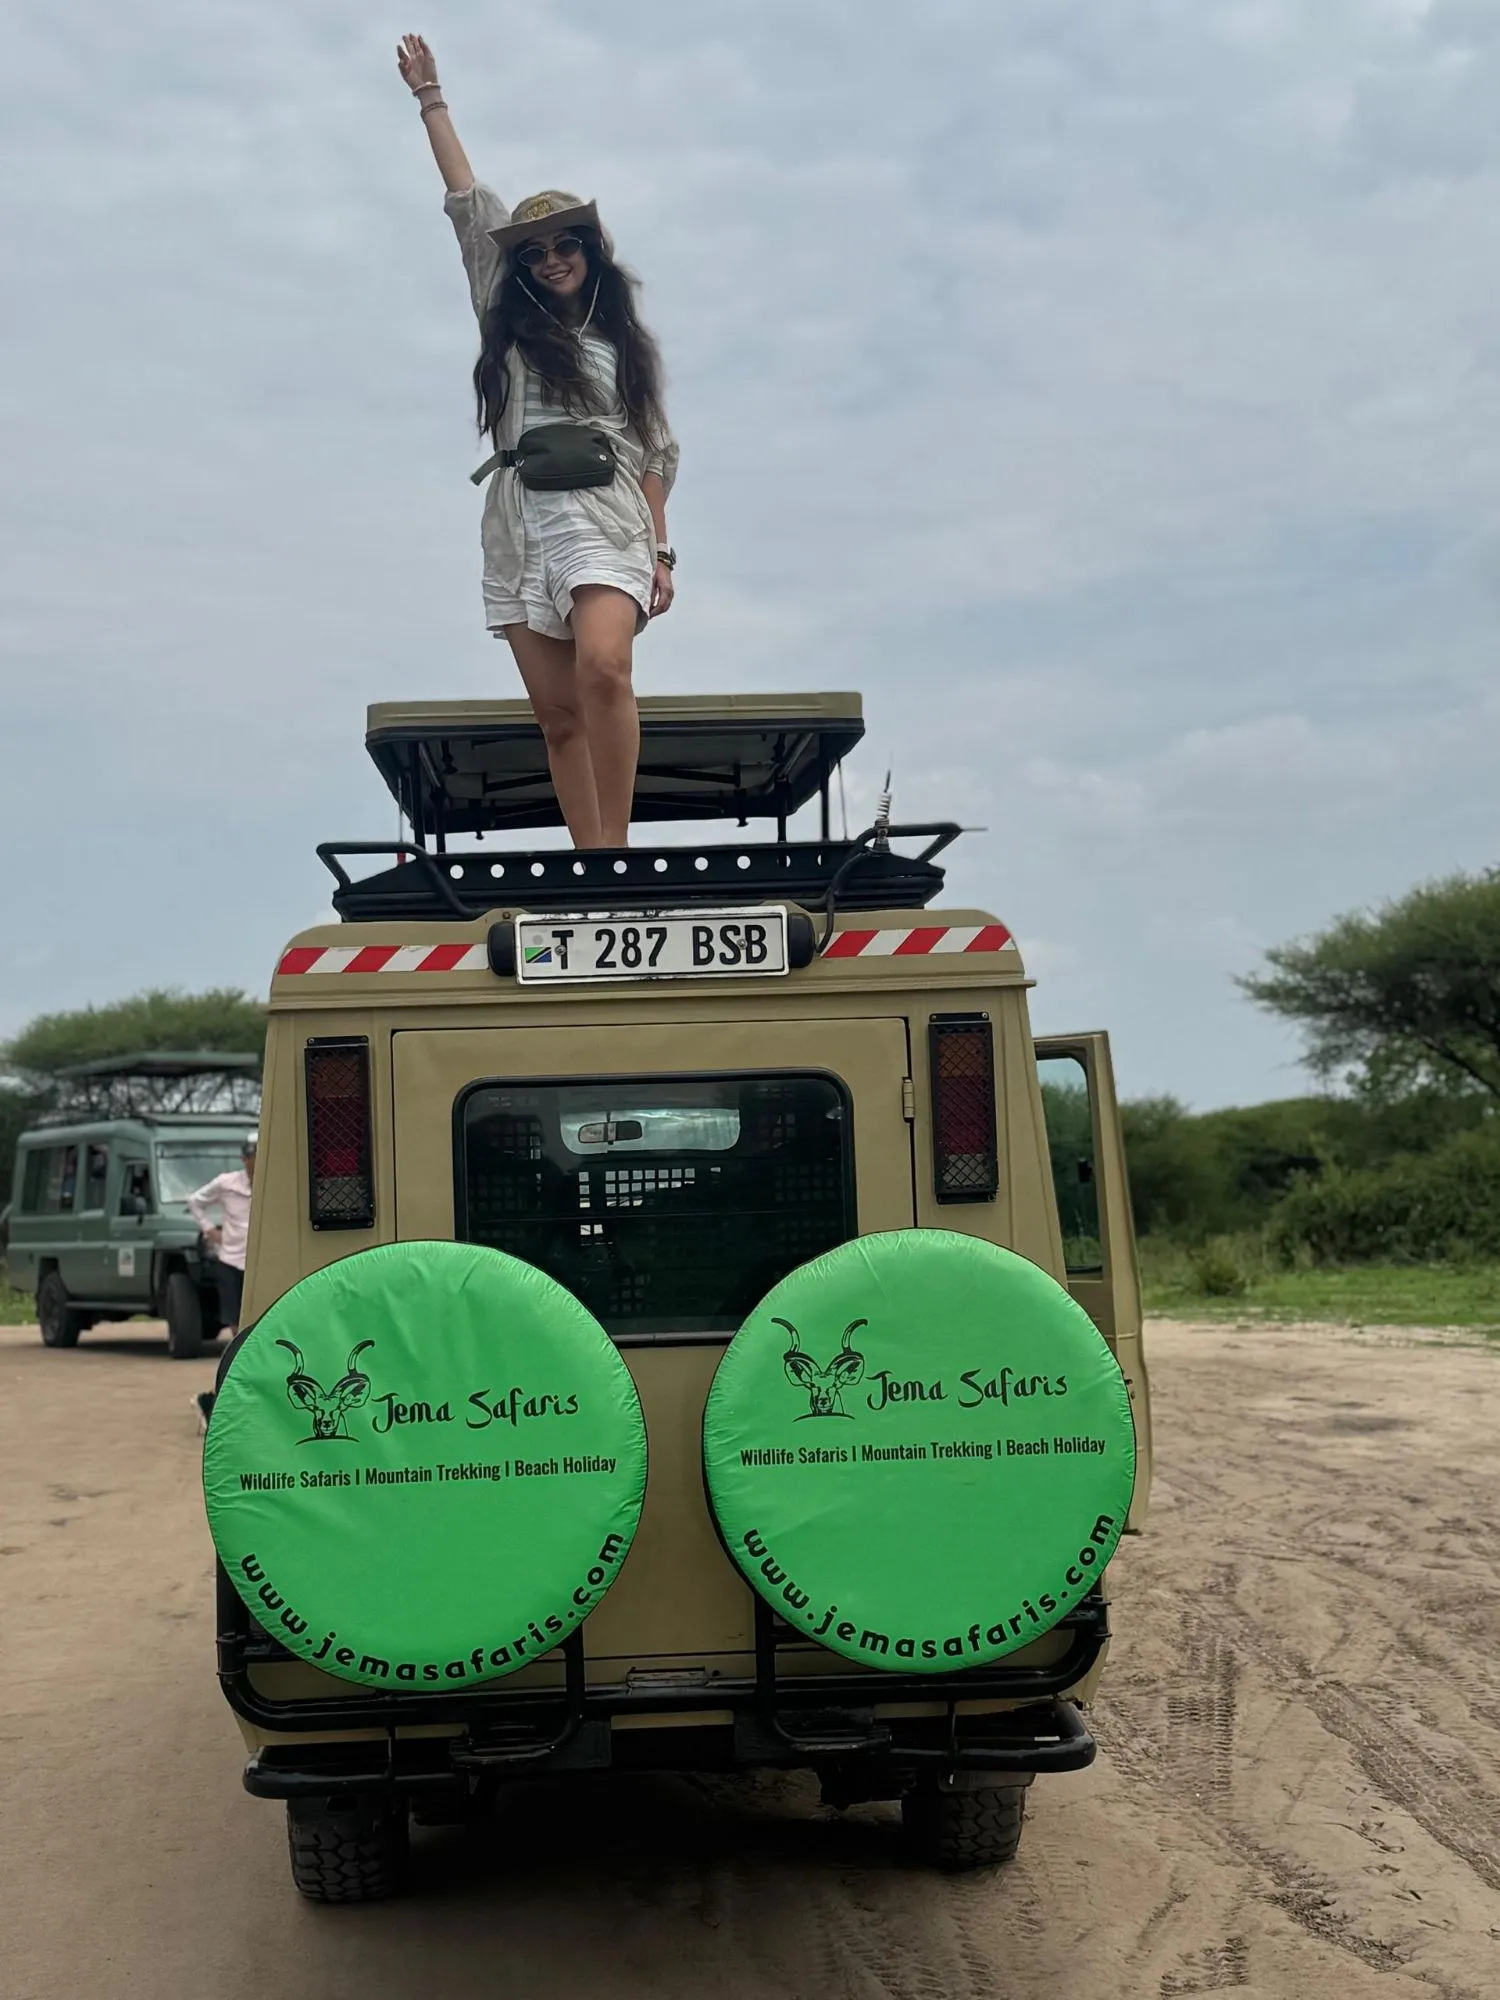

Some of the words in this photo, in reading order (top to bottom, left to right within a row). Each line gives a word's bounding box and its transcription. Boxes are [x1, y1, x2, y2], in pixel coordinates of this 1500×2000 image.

[552, 929, 574, 969] T
[595, 927, 668, 968] 287
[692, 924, 768, 966] BSB
[371, 1392, 455, 1433] Jema
[466, 1387, 579, 1429] Safaris
[866, 1370, 948, 1411] Jema
[957, 1367, 1068, 1408] Safaris
[239, 1472, 295, 1491] Wildlife
[300, 1470, 351, 1488] Safaris
[365, 1466, 432, 1485] Mountain
[436, 1462, 501, 1482] Trekking
[514, 1458, 559, 1477] Beach
[563, 1455, 617, 1474] Holiday
[740, 1448, 794, 1466] Wildlife
[798, 1447, 848, 1464] Safaris
[861, 1444, 927, 1462] Mountain
[930, 1441, 993, 1460] Trekking
[1006, 1437, 1049, 1456] Beach
[1053, 1436, 1106, 1455] Holiday
[240, 1532, 625, 1682] www.jemasafaris.com
[743, 1513, 1115, 1659] www.jemasafaris.com
